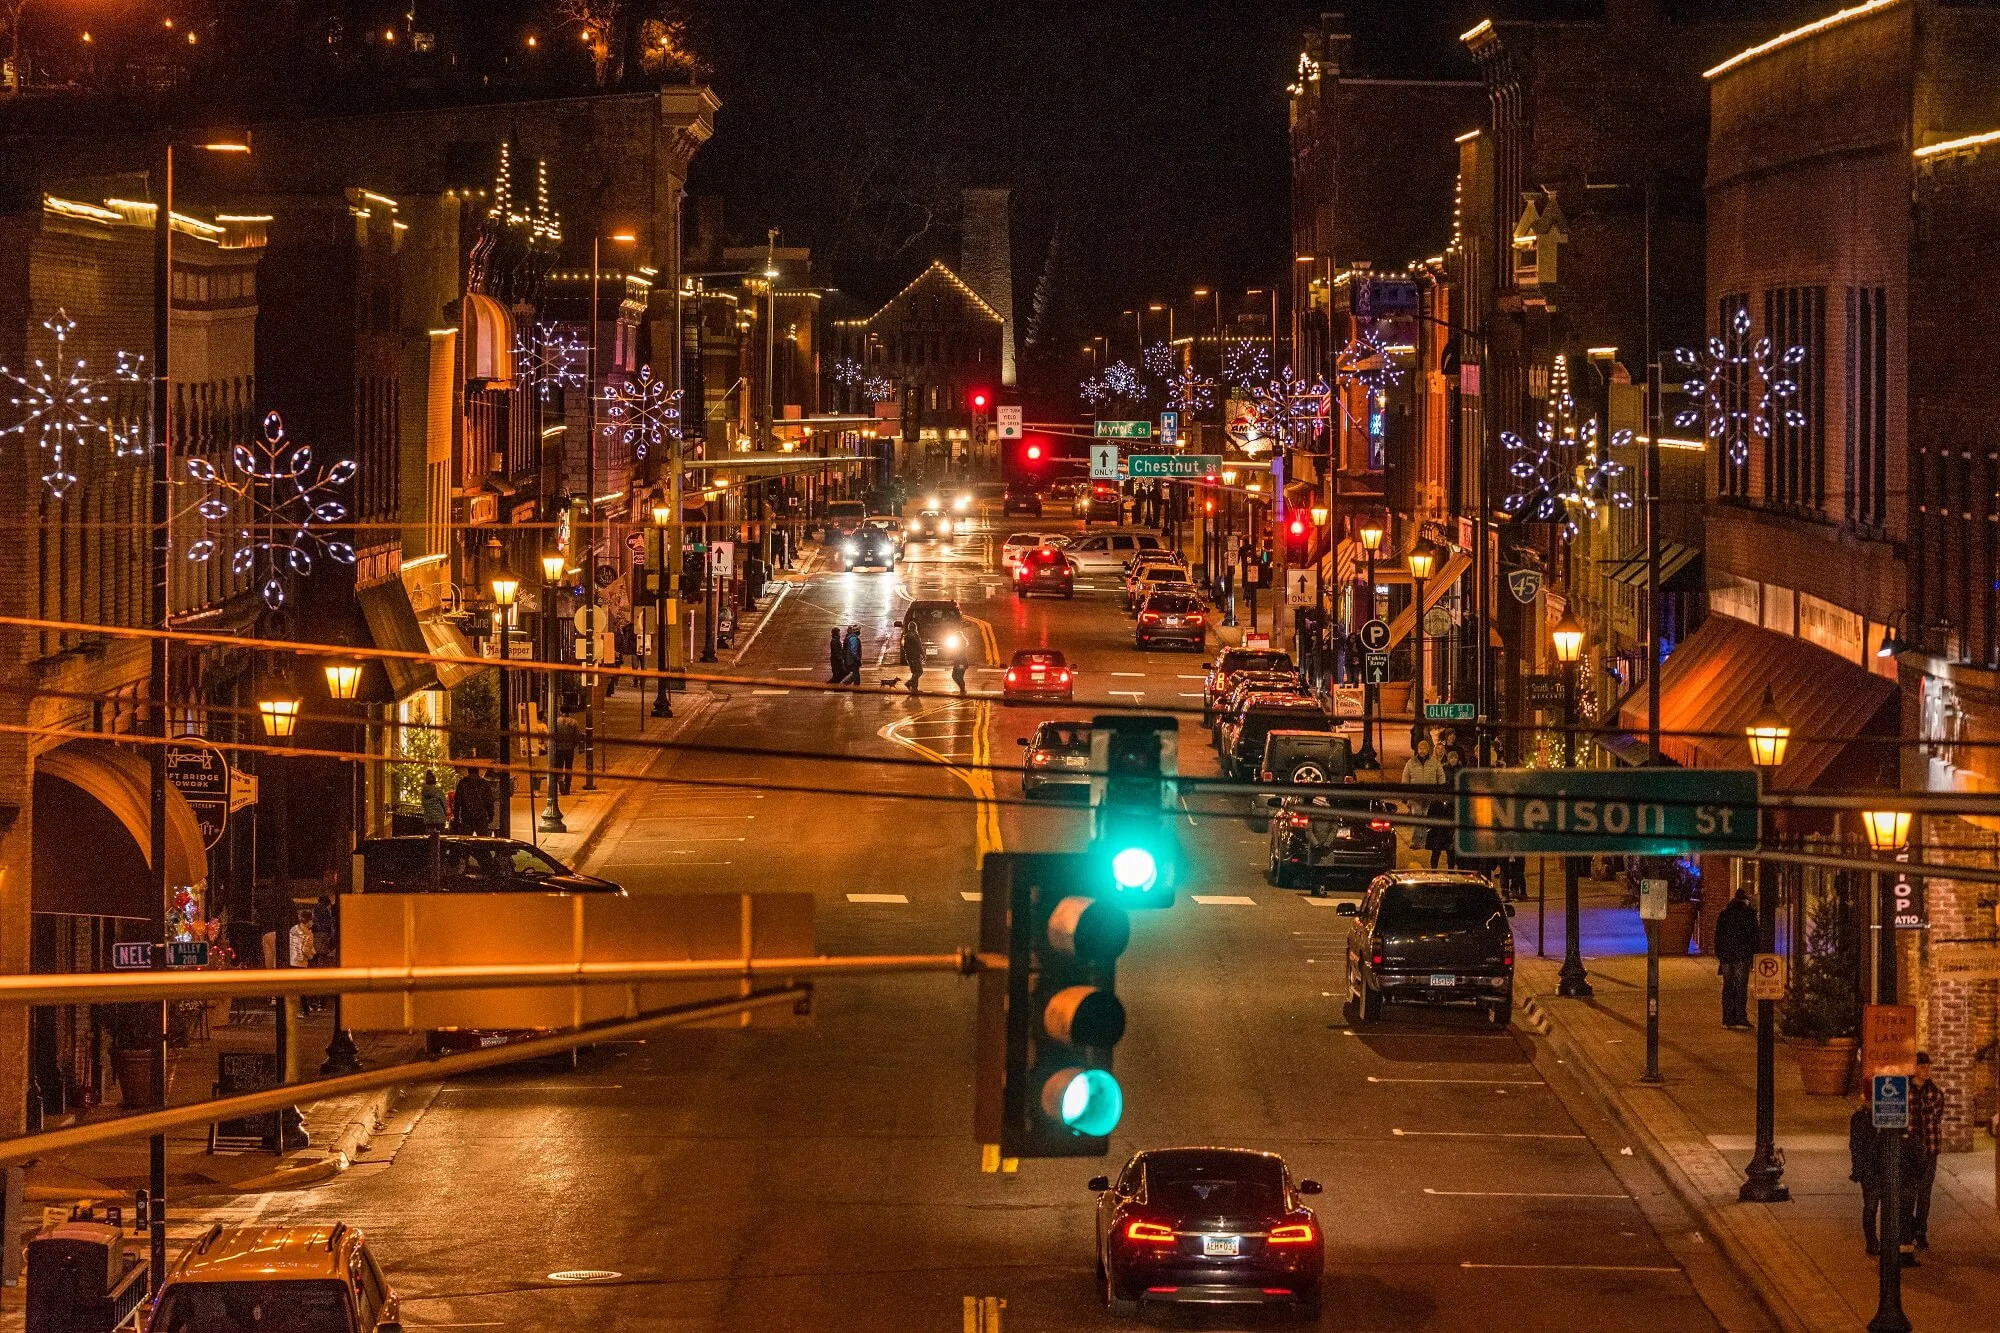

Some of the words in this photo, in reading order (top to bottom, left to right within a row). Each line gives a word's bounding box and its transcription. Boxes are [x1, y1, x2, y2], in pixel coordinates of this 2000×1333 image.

[1138, 427, 1146, 435] St
[1134, 460, 1199, 473] Chestnut
[1206, 463, 1217, 473] St
[1291, 595, 1313, 603] ONLY
[508, 647, 530, 656] apper
[1429, 706, 1454, 718] OLIVE
[174, 780, 209, 788] OWORK
[1490, 790, 1665, 835] Nelson
[1695, 804, 1734, 835] St
[1894, 915, 1919, 925] ATIO
[119, 945, 175, 965] NELSN
[178, 943, 201, 954] ALLEY
[182, 954, 197, 965] 200
